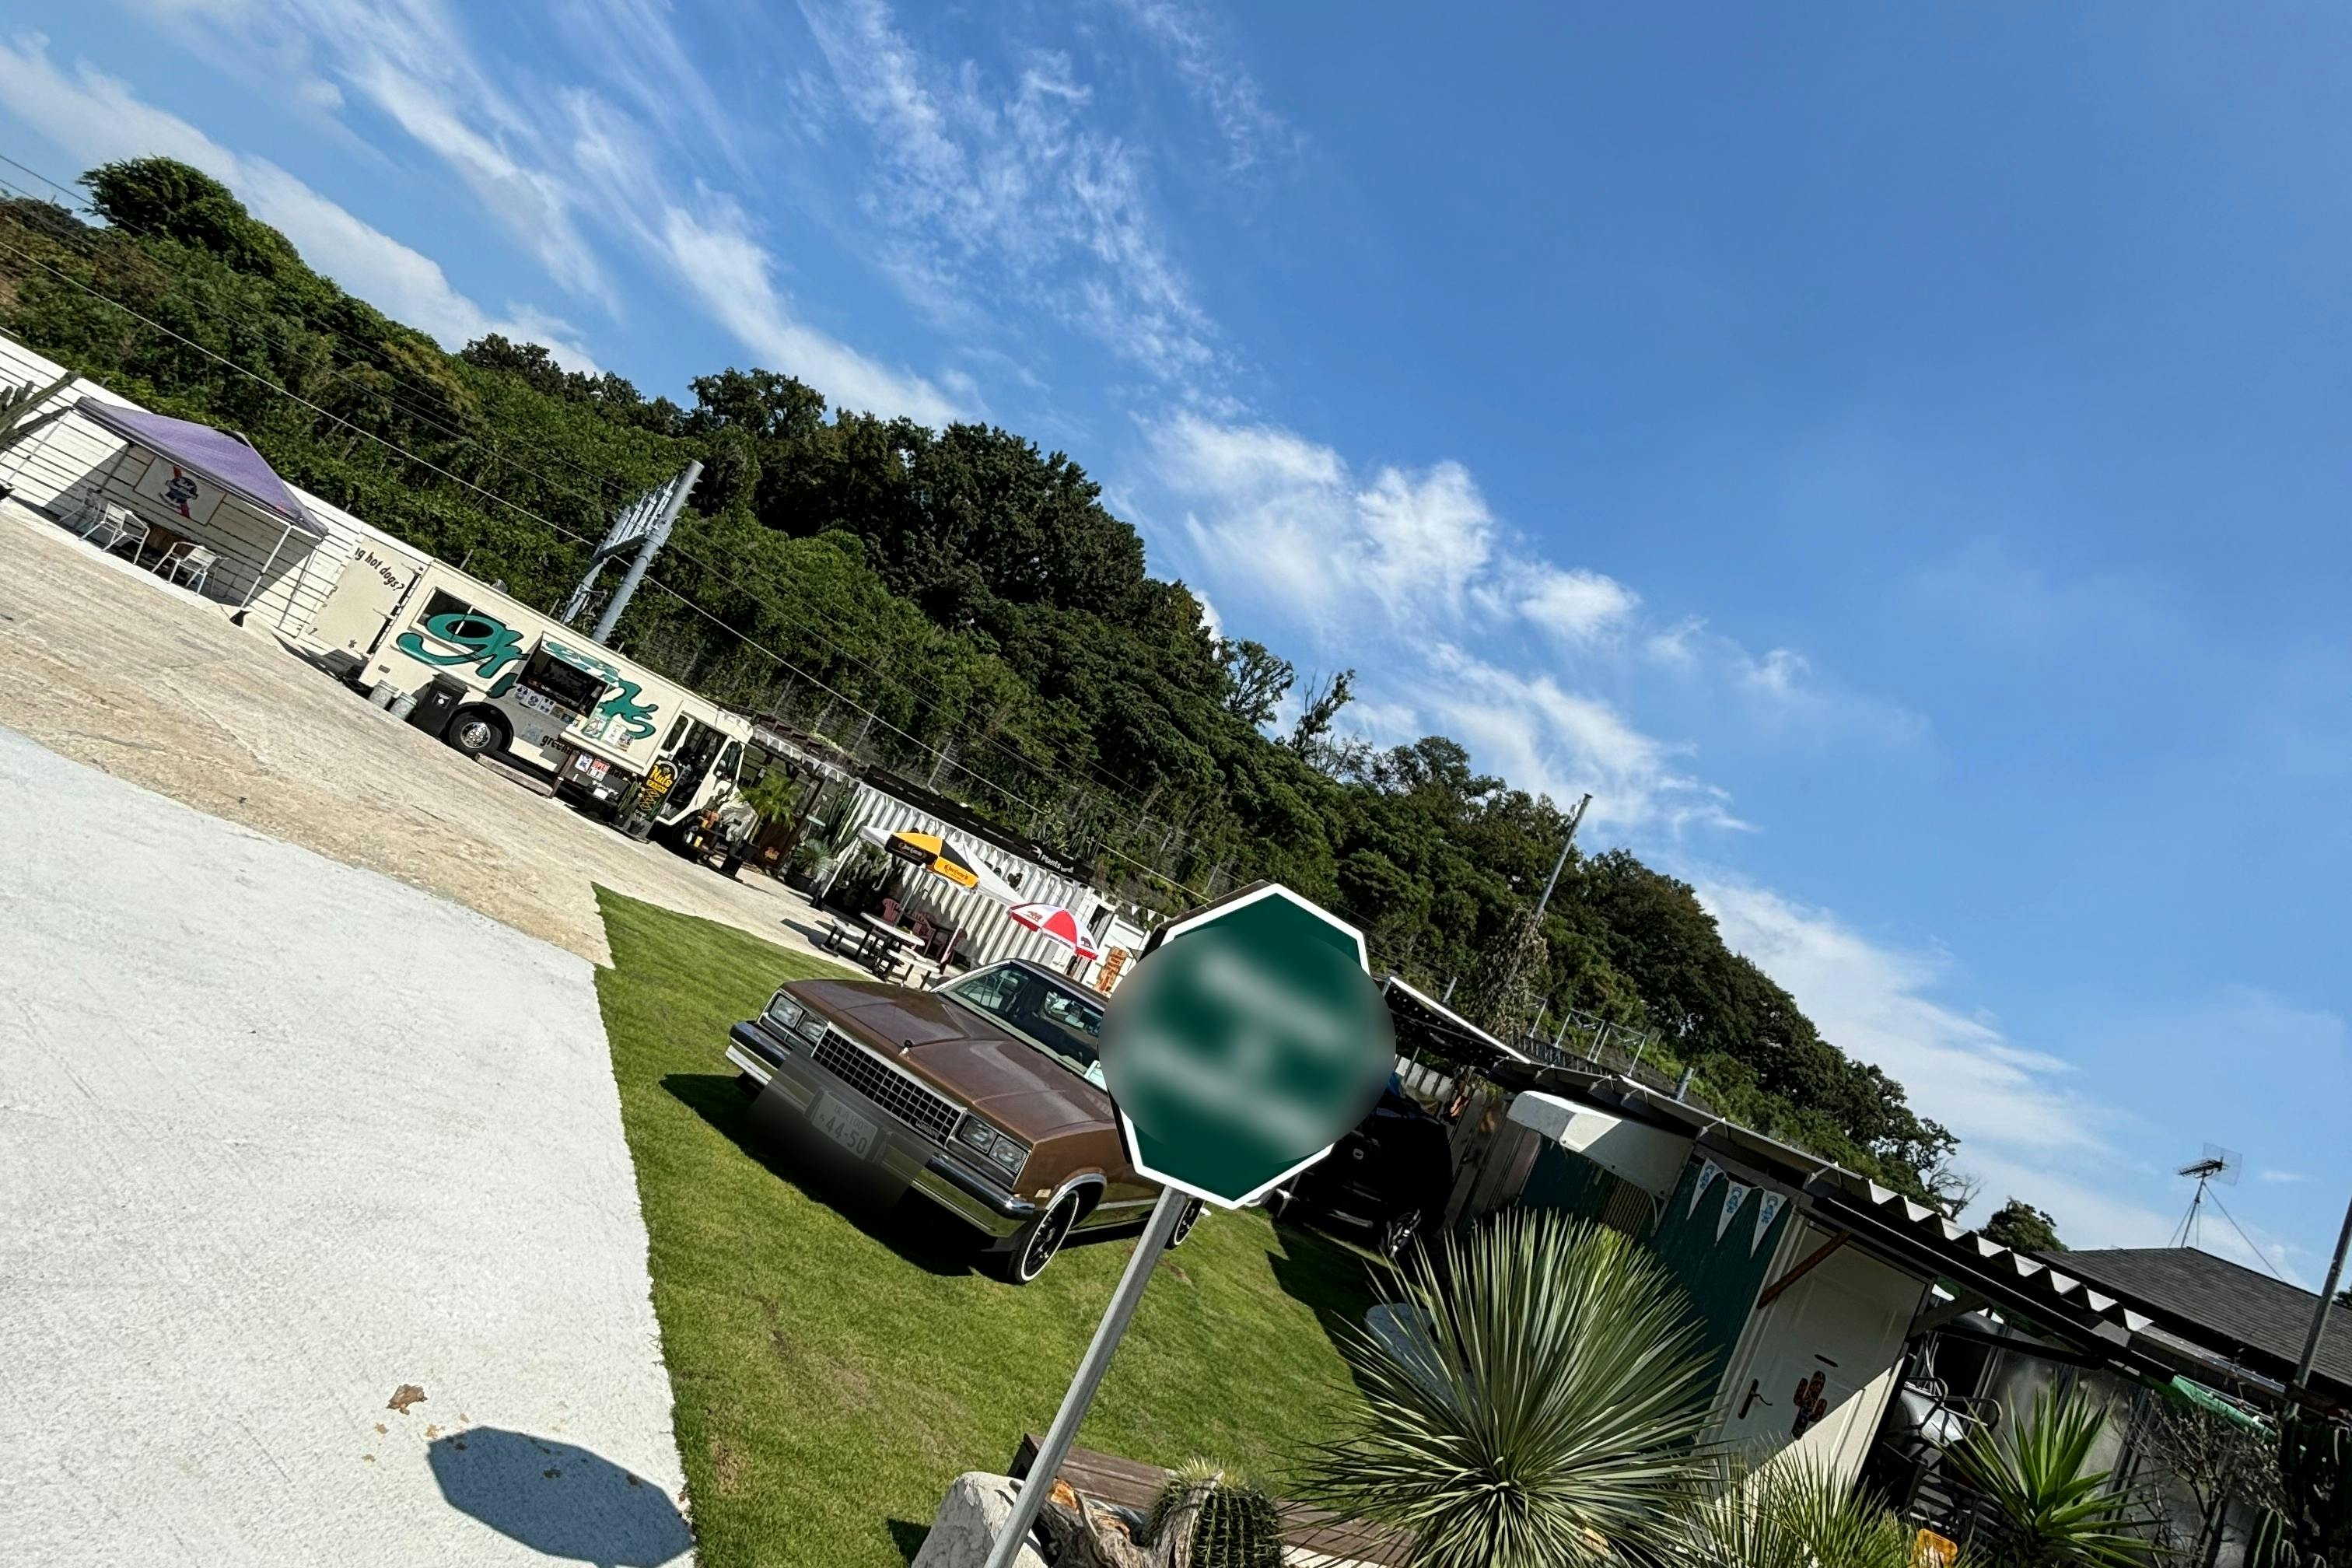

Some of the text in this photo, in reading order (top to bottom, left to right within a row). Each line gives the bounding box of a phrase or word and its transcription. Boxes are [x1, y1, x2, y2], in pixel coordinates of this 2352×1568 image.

[364, 551, 383, 569] hot
[379, 566, 405, 591] dogs?
[649, 765, 673, 788] Nuts
